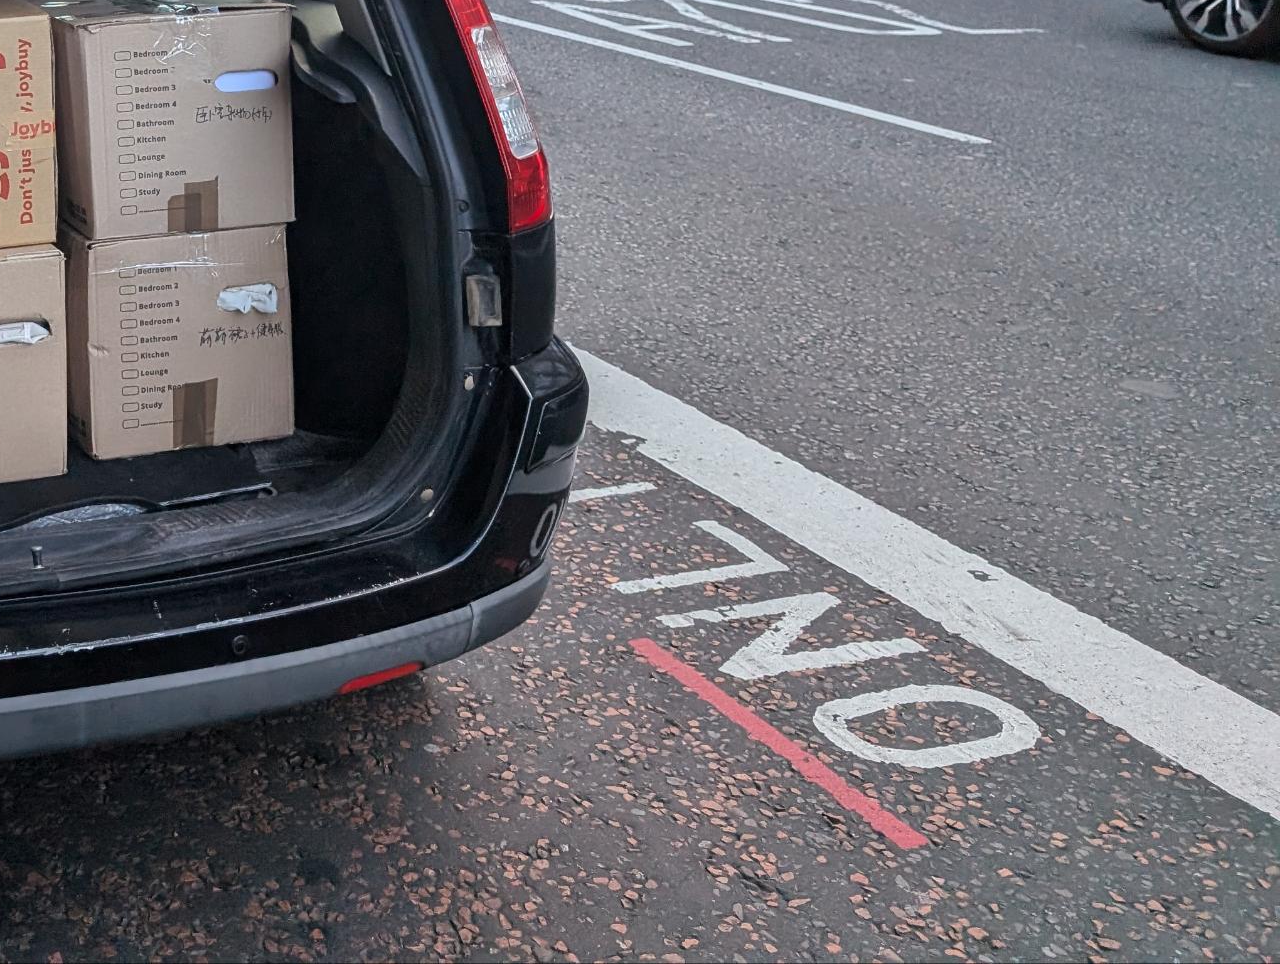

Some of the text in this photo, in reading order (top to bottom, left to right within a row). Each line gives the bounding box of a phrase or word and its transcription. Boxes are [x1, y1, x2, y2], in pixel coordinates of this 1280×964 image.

[133, 50, 168, 58] Bedroom
[15, 38, 33, 98] joybuy
[134, 67, 169, 76] Bedroom
[134, 85, 170, 93] Bedroom
[135, 102, 171, 110] Bedroom
[136, 119, 175, 128] Bathroom
[136, 136, 166, 144] Kitchen
[18, 149, 36, 174] jus
[137, 153, 166, 162] Lounge
[138, 169, 187, 179] Dining Room
[138, 188, 161, 197] Study
[19, 181, 33, 225] Don't
[137, 267, 173, 275] Bedroom
[138, 284, 173, 292] Bedroom
[138, 301, 174, 310] Bedroom
[139, 318, 174, 327] Bedroom
[140, 335, 178, 343] Bathroom
[140, 351, 170, 359] Kitchen
[140, 368, 169, 377] Lounge
[141, 385, 166, 394] Dining
[140, 401, 163, 410] Study
[570, 480, 1043, 770] ONL
